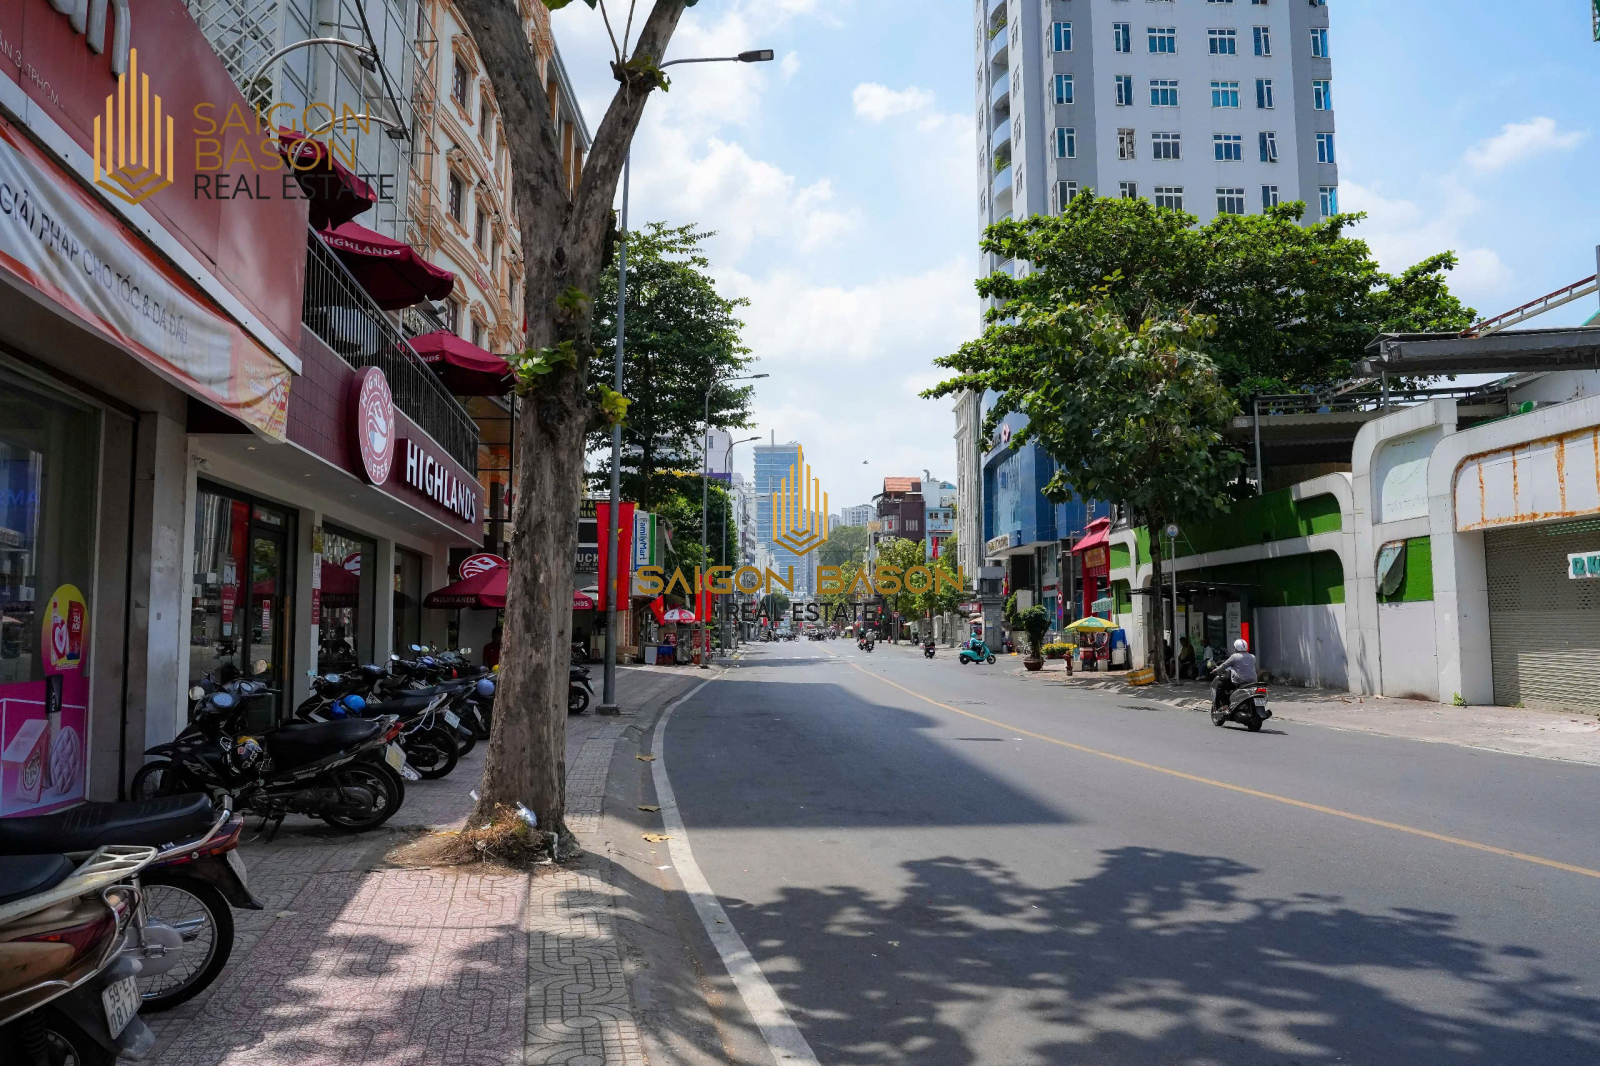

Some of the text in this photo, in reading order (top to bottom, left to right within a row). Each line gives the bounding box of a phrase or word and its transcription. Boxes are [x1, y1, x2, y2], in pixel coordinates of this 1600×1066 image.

[0, 183, 35, 232] GIẢI
[38, 213, 79, 261] PHÁP
[83, 249, 112, 290] CHO
[116, 272, 140, 310] TÓC
[142, 294, 149, 318] &
[152, 301, 167, 331] DA
[320, 233, 401, 256] HIGHLANDS
[361, 373, 395, 429] HIGHLANDS
[364, 446, 389, 479] COFFEE
[406, 438, 477, 524] HIGHLANDS
[639, 517, 648, 561] FamilyMart
